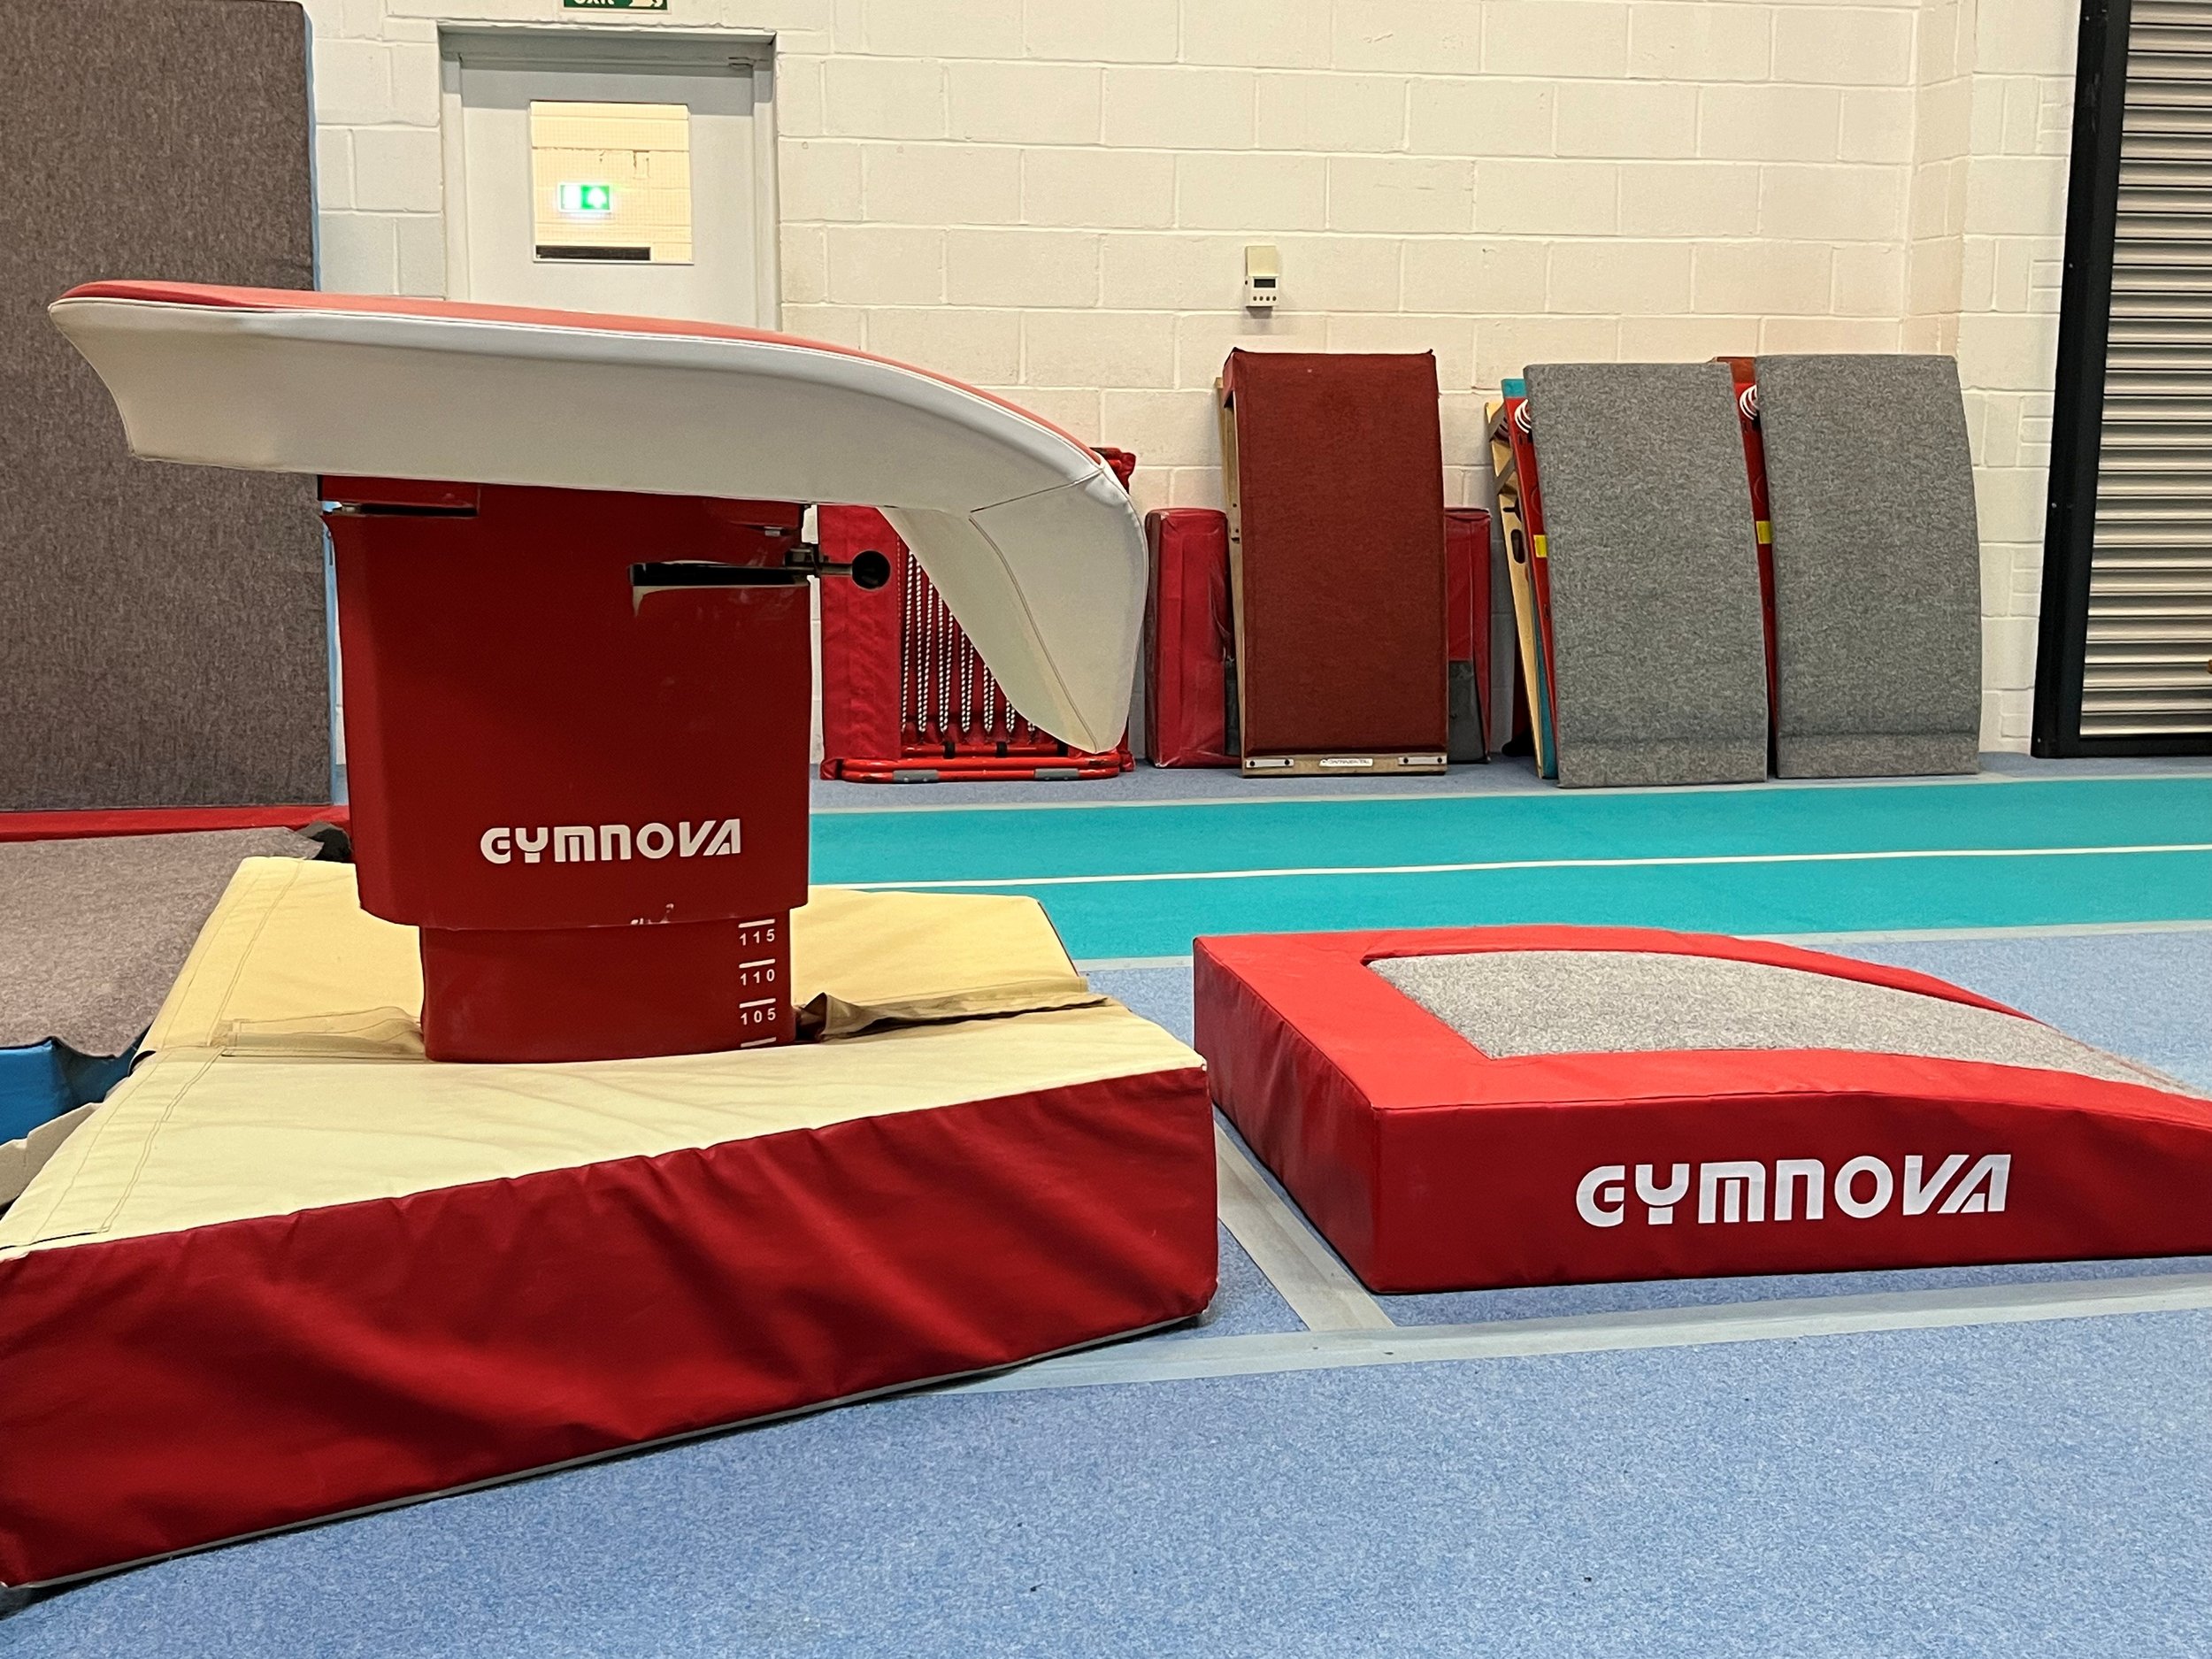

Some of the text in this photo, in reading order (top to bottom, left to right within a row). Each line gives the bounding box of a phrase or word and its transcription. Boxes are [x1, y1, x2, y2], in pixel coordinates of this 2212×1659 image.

[480, 818, 741, 864] GYMNOVA
[739, 928, 775, 946] 115
[740, 968, 775, 986] 110
[740, 1007, 776, 1025] 105
[1576, 1154, 2012, 1227] GYMNOVA
